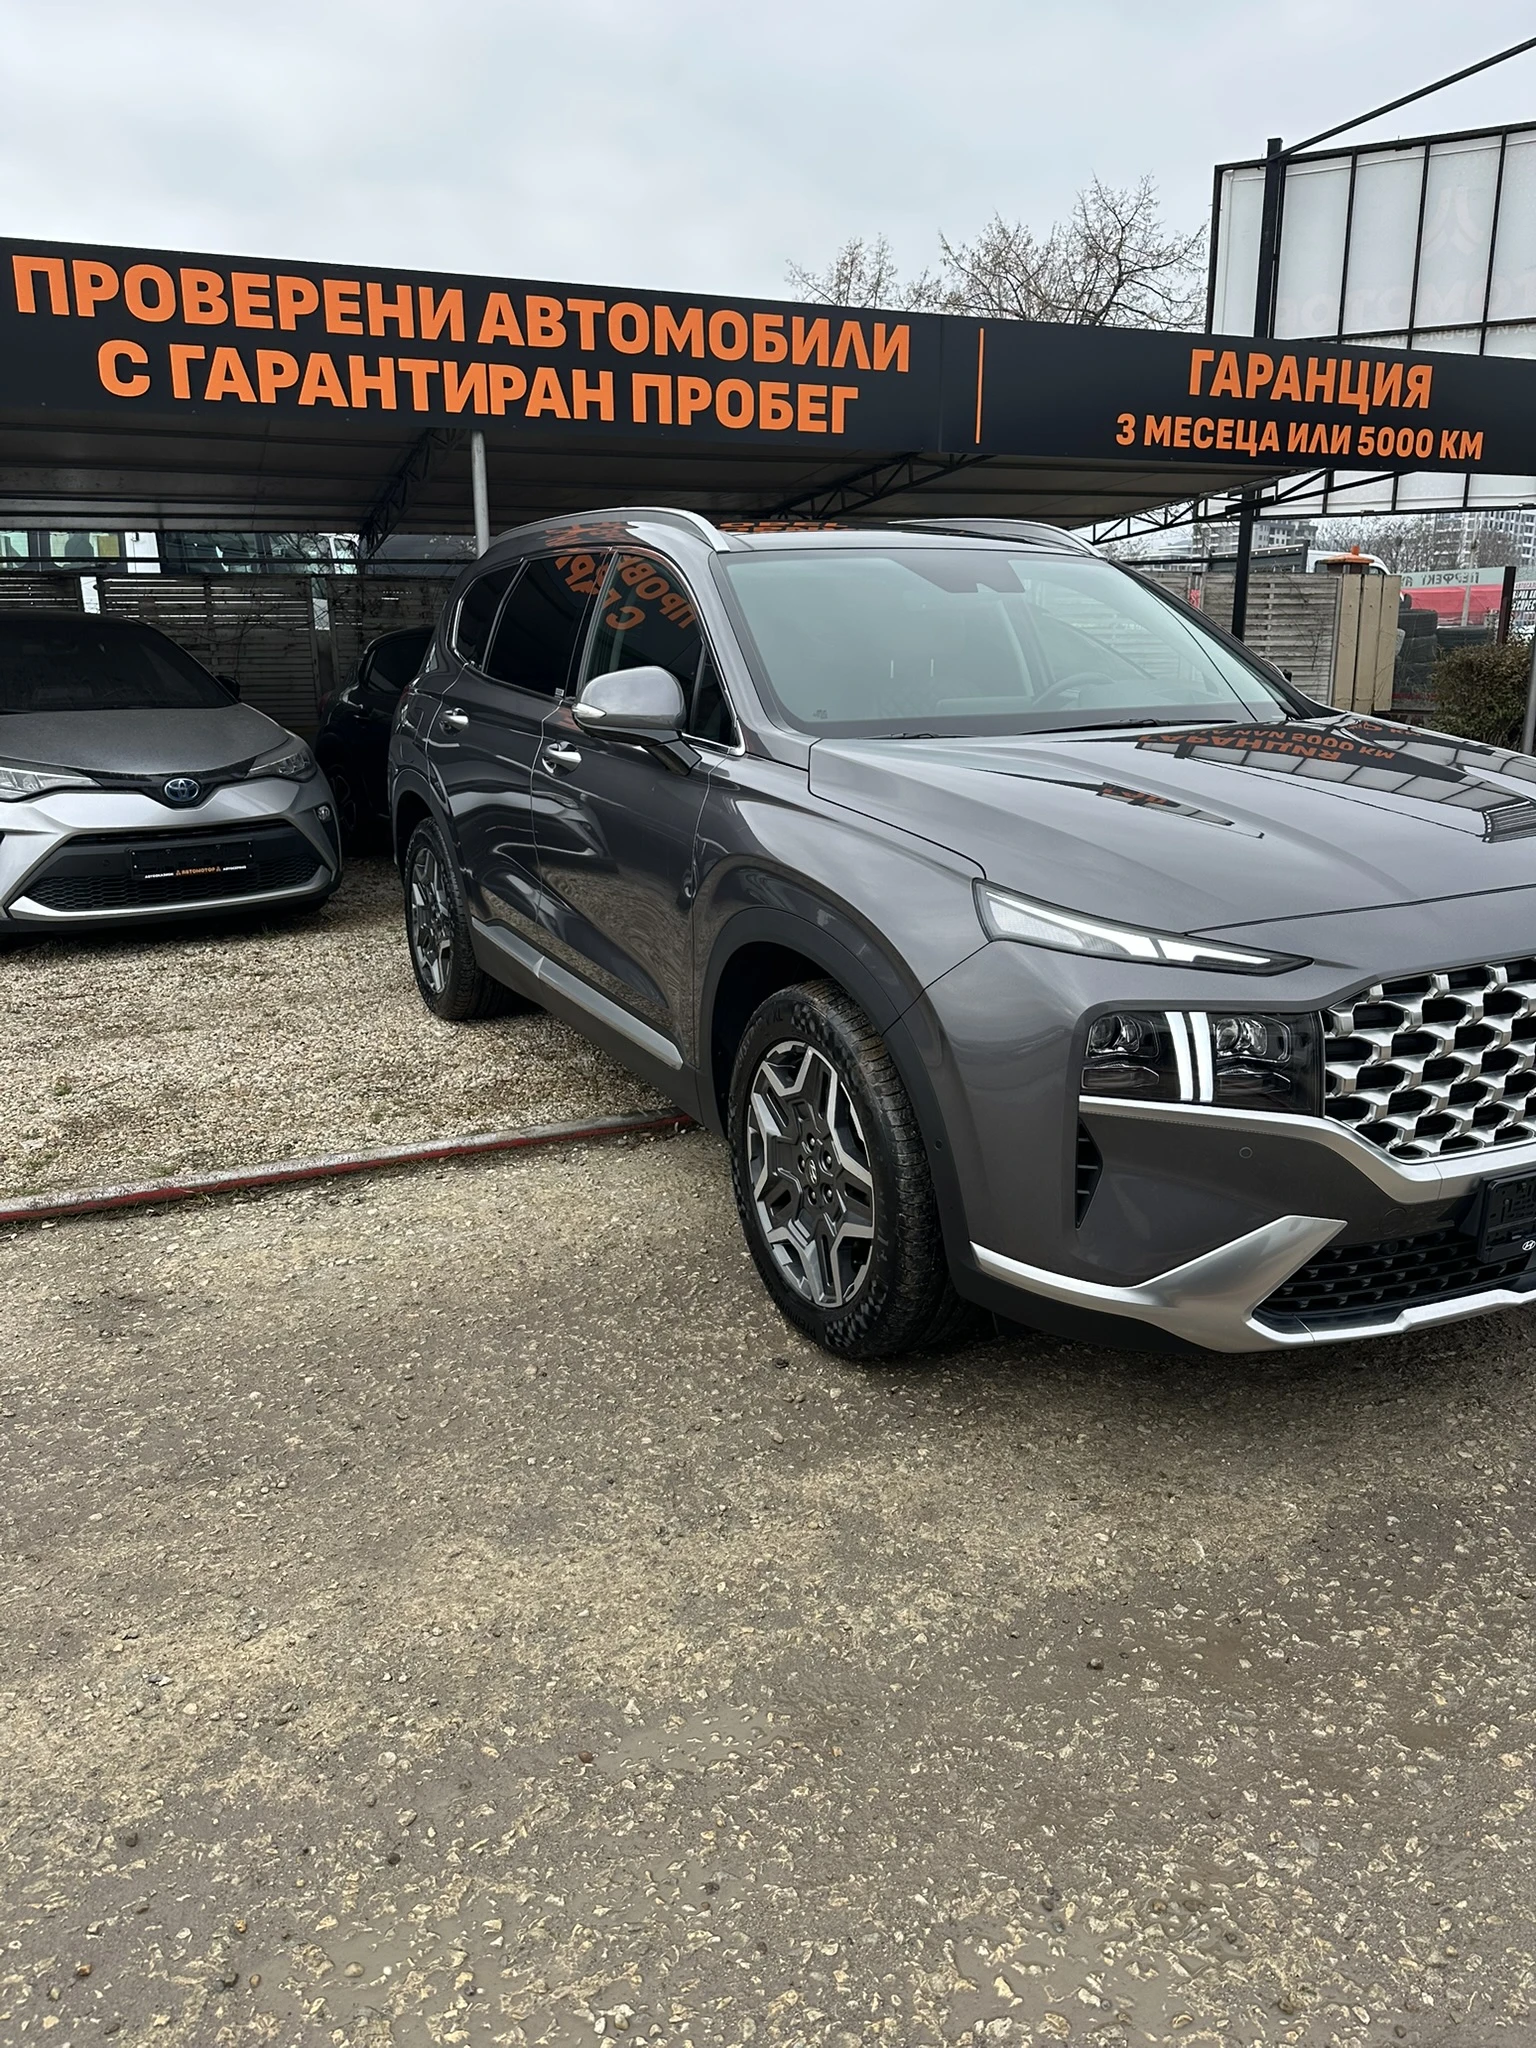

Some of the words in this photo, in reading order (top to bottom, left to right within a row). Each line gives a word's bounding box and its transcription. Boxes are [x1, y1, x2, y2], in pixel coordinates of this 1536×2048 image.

[12, 255, 464, 342] ПРОВЕРЕНИ
[478, 293, 909, 373] АВТОМОБИЛИ
[98, 341, 149, 397] С
[169, 345, 613, 420] ГАРАНТИРАН
[632, 374, 858, 434] ПРОБЕГ
[1188, 350, 1433, 414] ГАРАНЦИЯ
[1116, 414, 1135, 446] 3
[1144, 416, 1279, 456] МЕСЕЦА
[1287, 423, 1351, 453] ИЛИ
[1357, 427, 1433, 457] 5000
[1438, 431, 1483, 459] КМ
